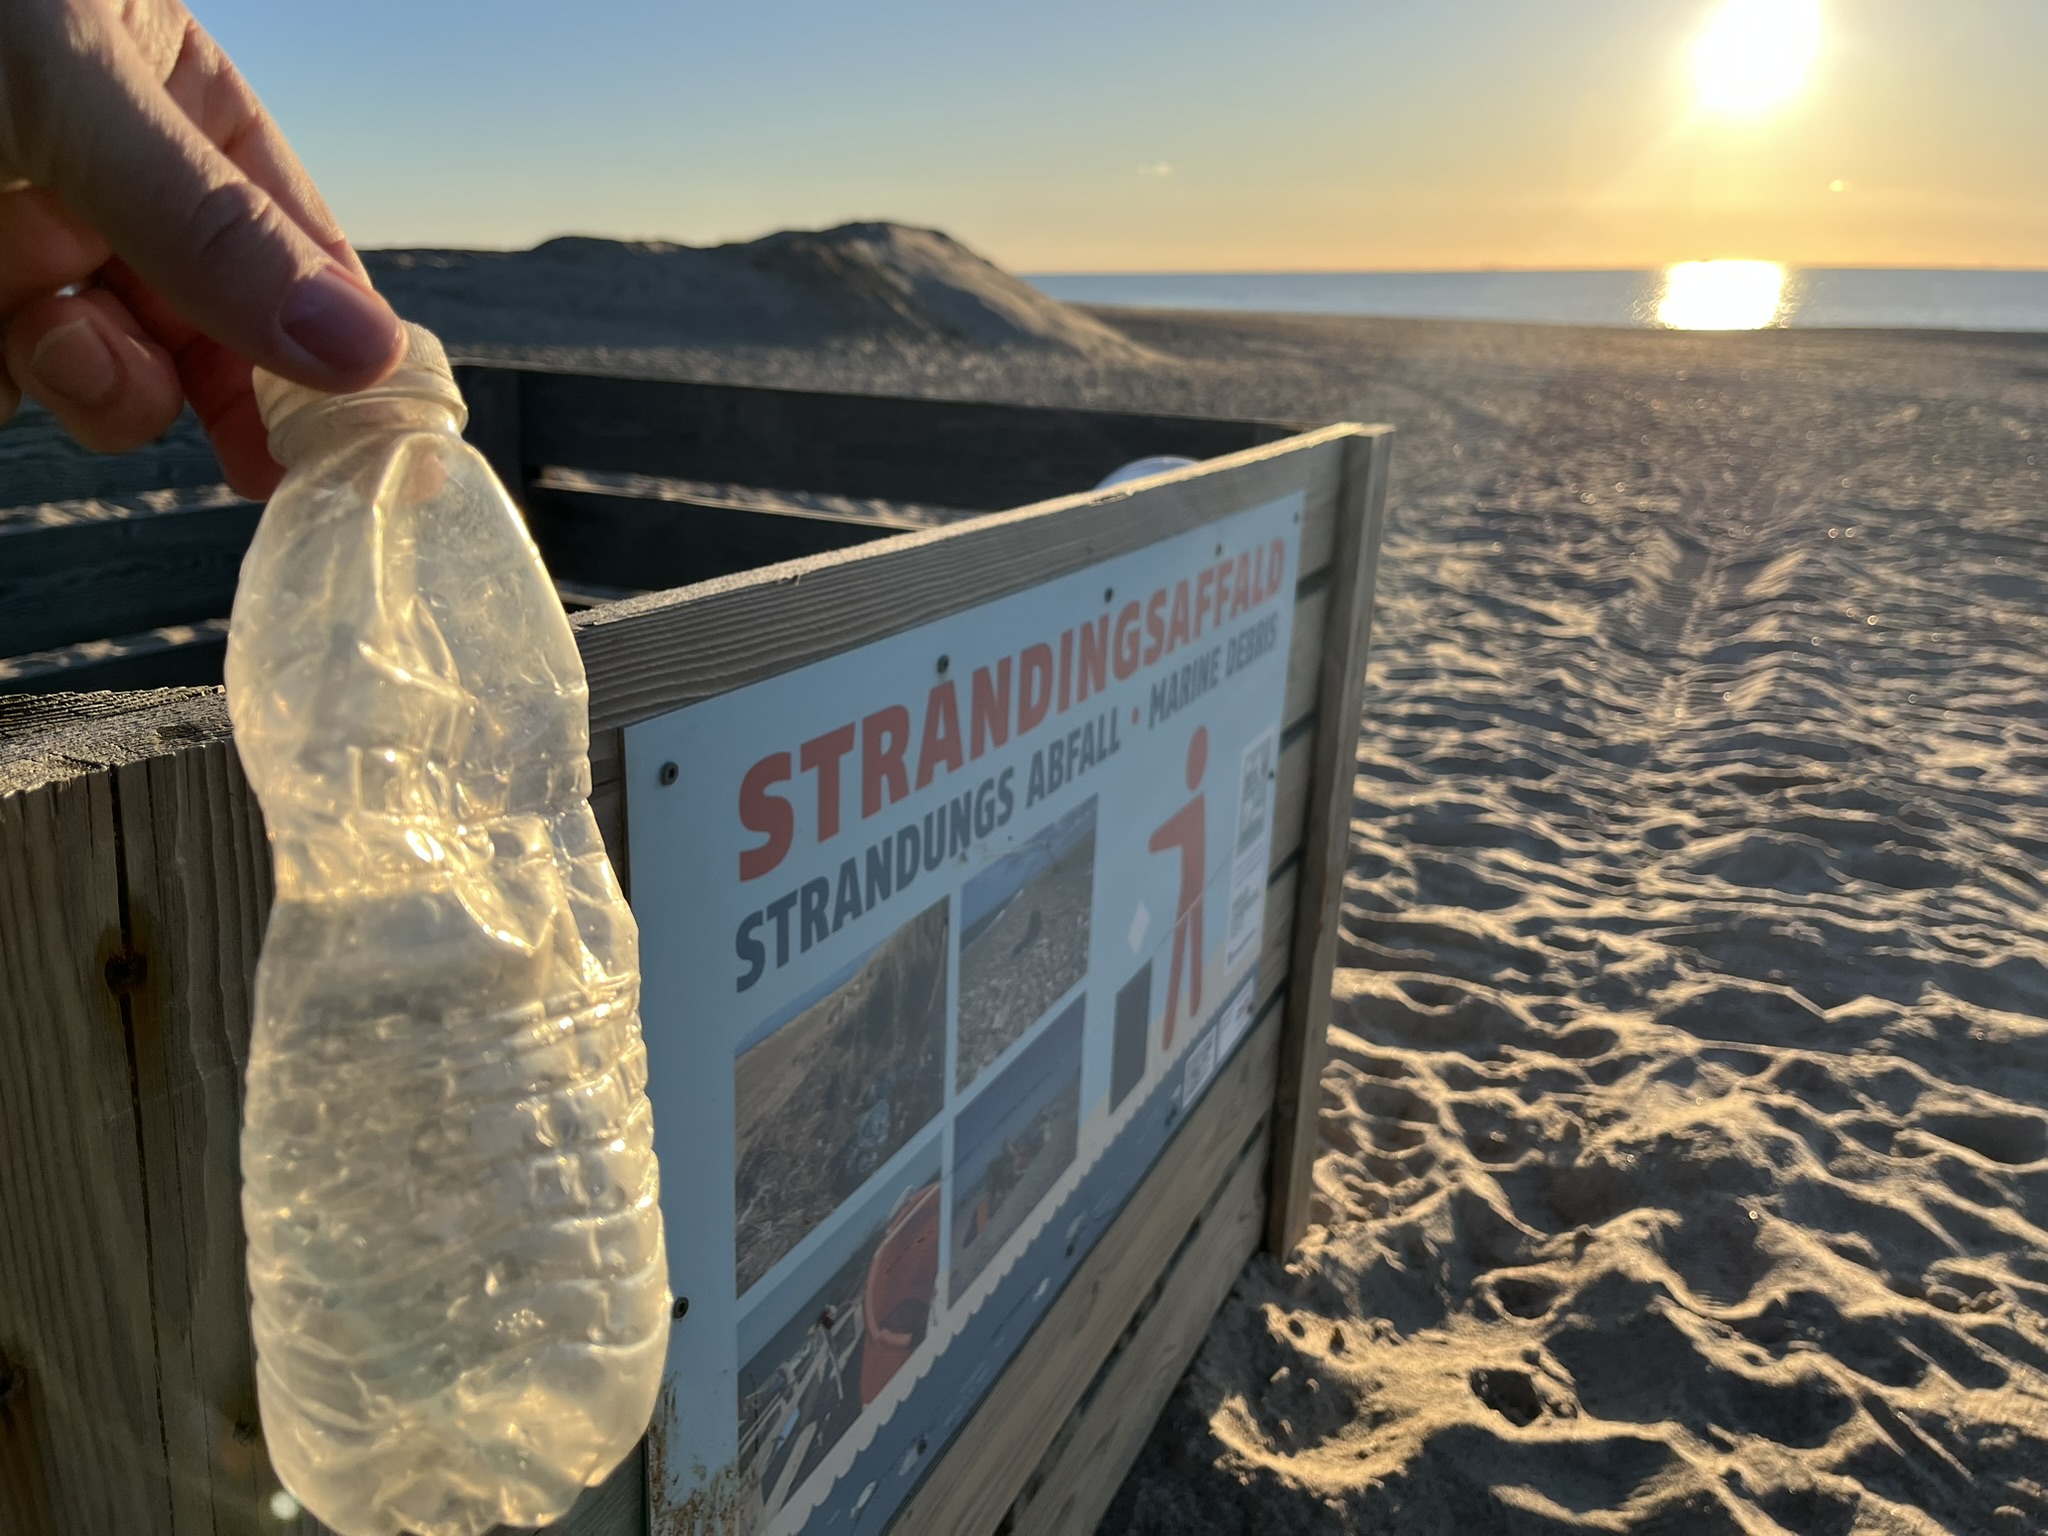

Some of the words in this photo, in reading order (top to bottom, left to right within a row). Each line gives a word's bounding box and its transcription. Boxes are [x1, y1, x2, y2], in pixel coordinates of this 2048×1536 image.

[735, 766, 1014, 993] STRANDUNGS
[1025, 706, 1121, 810] ABFALL
[1148, 645, 1221, 730] MARINE
[1225, 611, 1279, 678] DEBRIS
[739, 537, 1285, 883] STRANDINGSAFFALD
